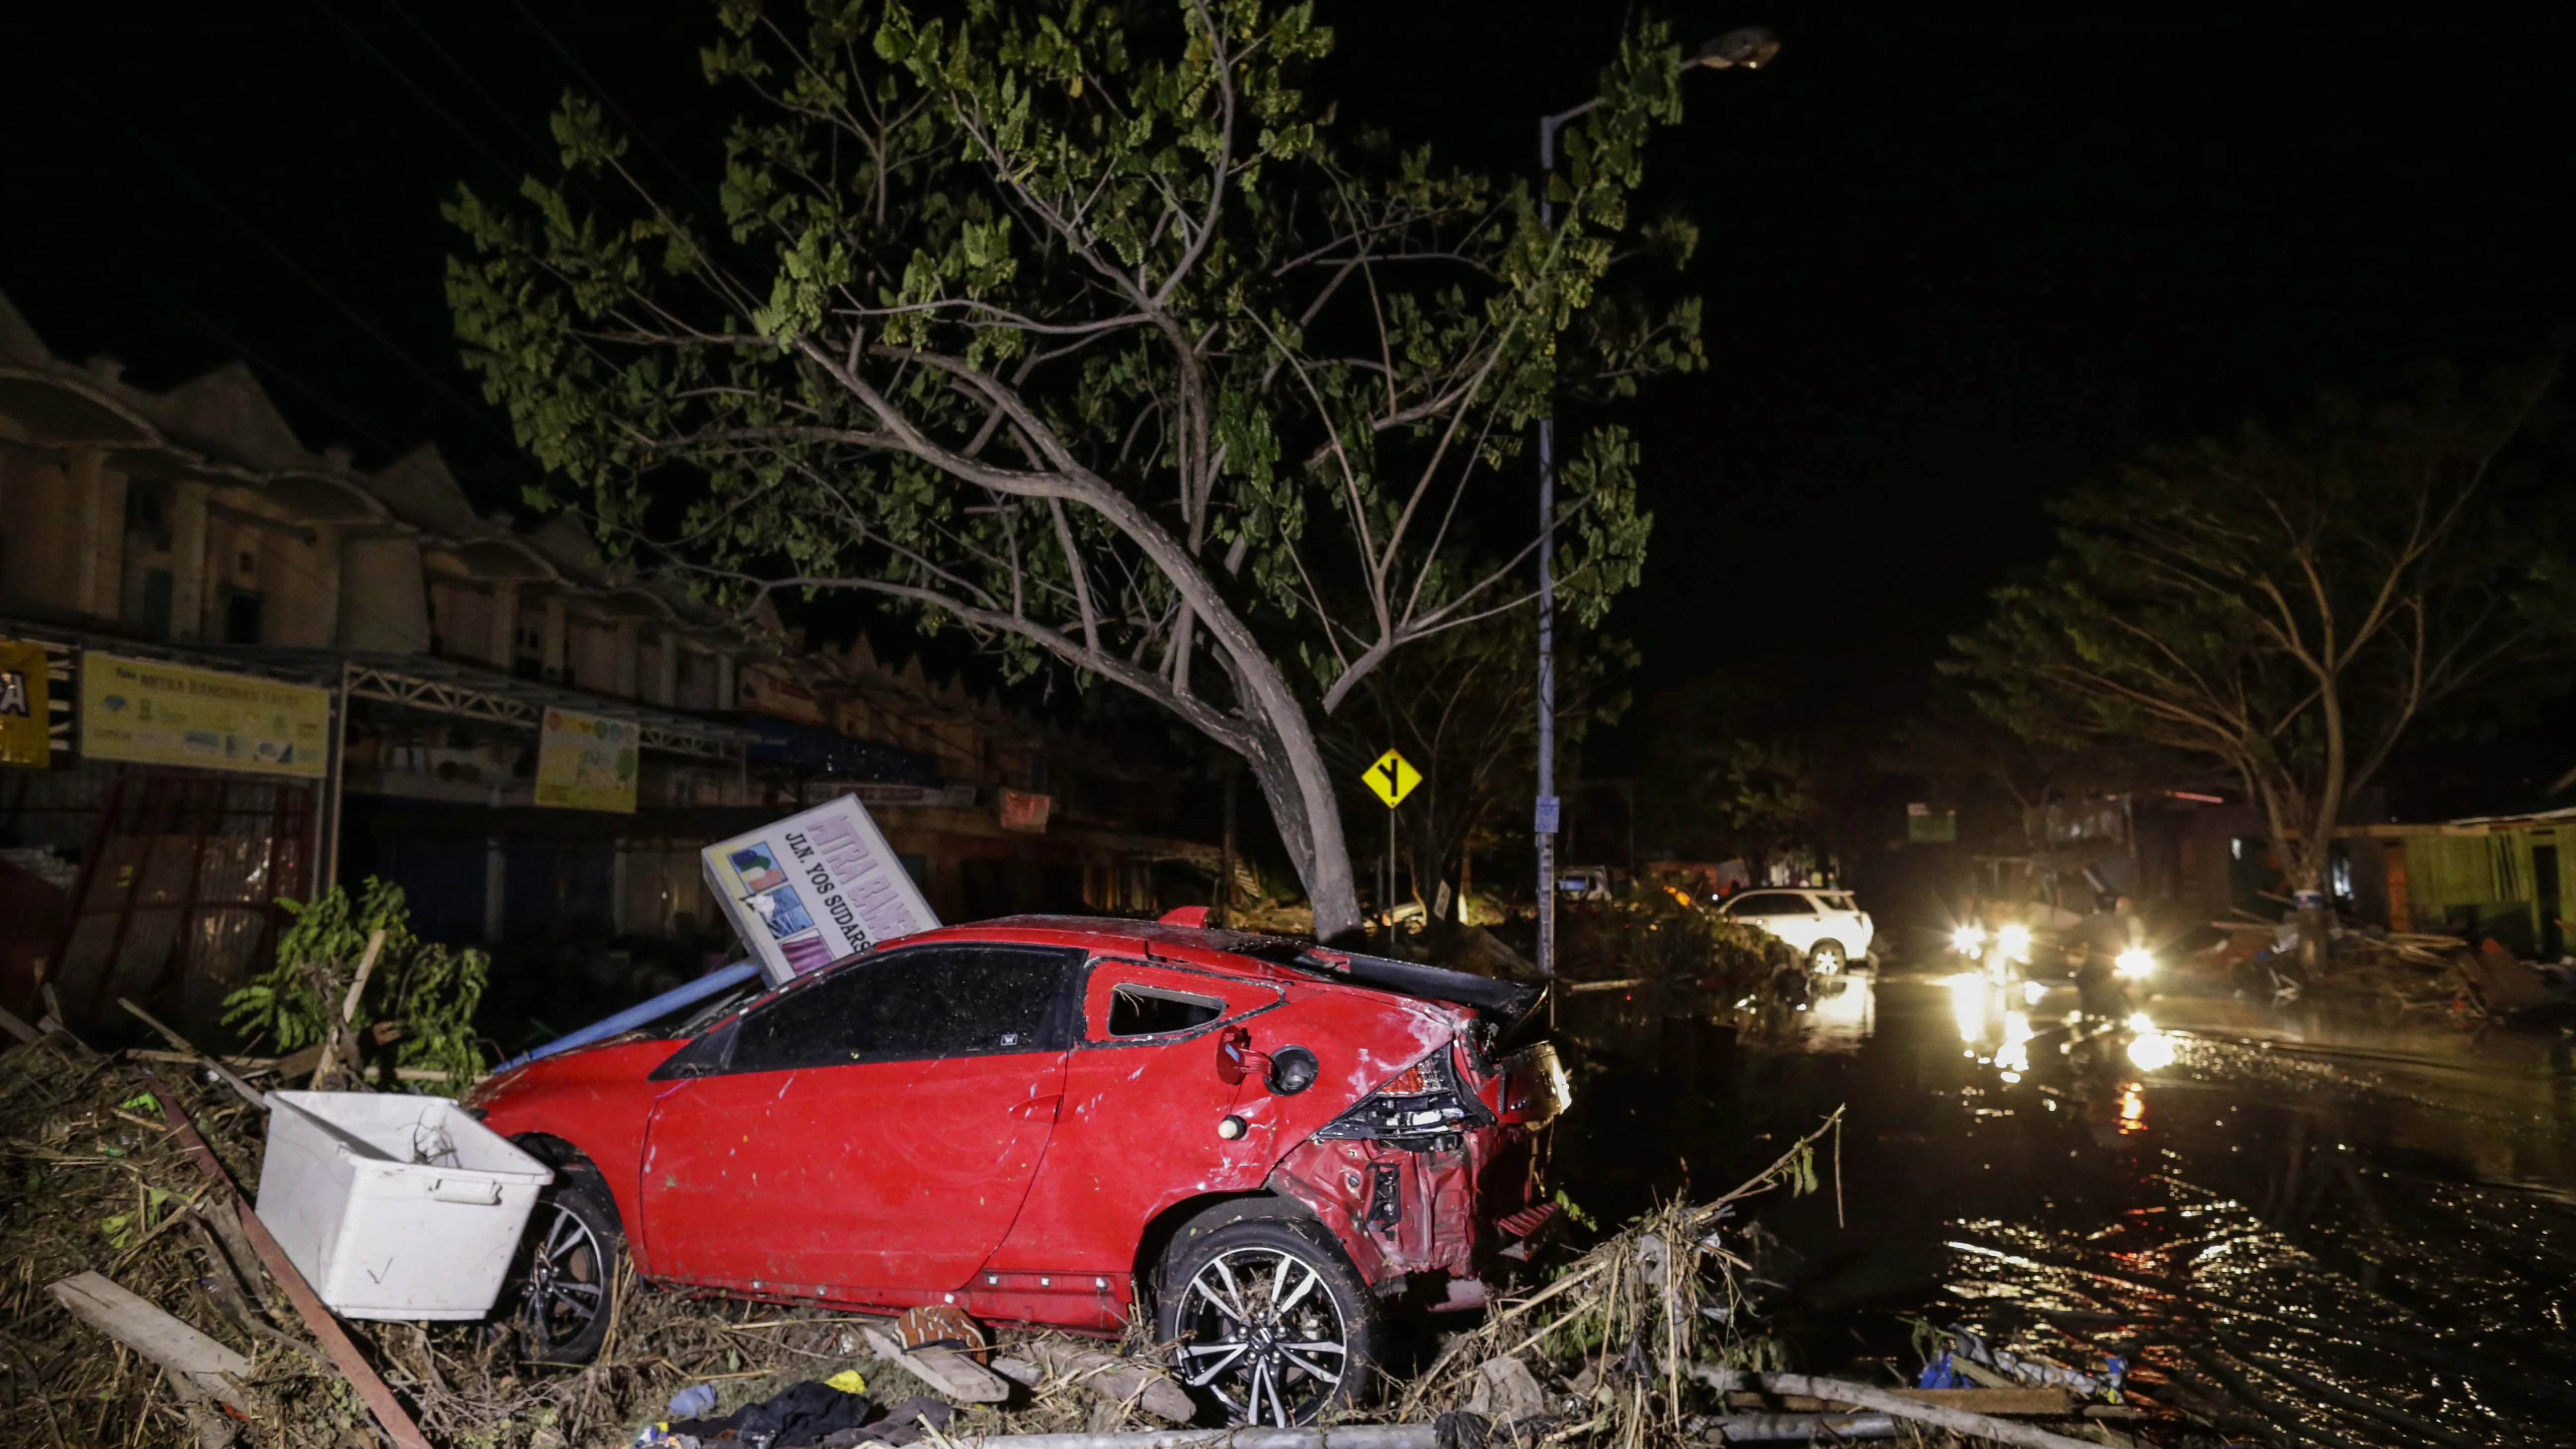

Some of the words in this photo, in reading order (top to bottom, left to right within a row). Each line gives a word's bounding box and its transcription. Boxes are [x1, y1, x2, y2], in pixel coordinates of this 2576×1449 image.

[785, 832, 814, 864] JLN.
[805, 862, 835, 894] YOS
[806, 813, 879, 885] MITRA
